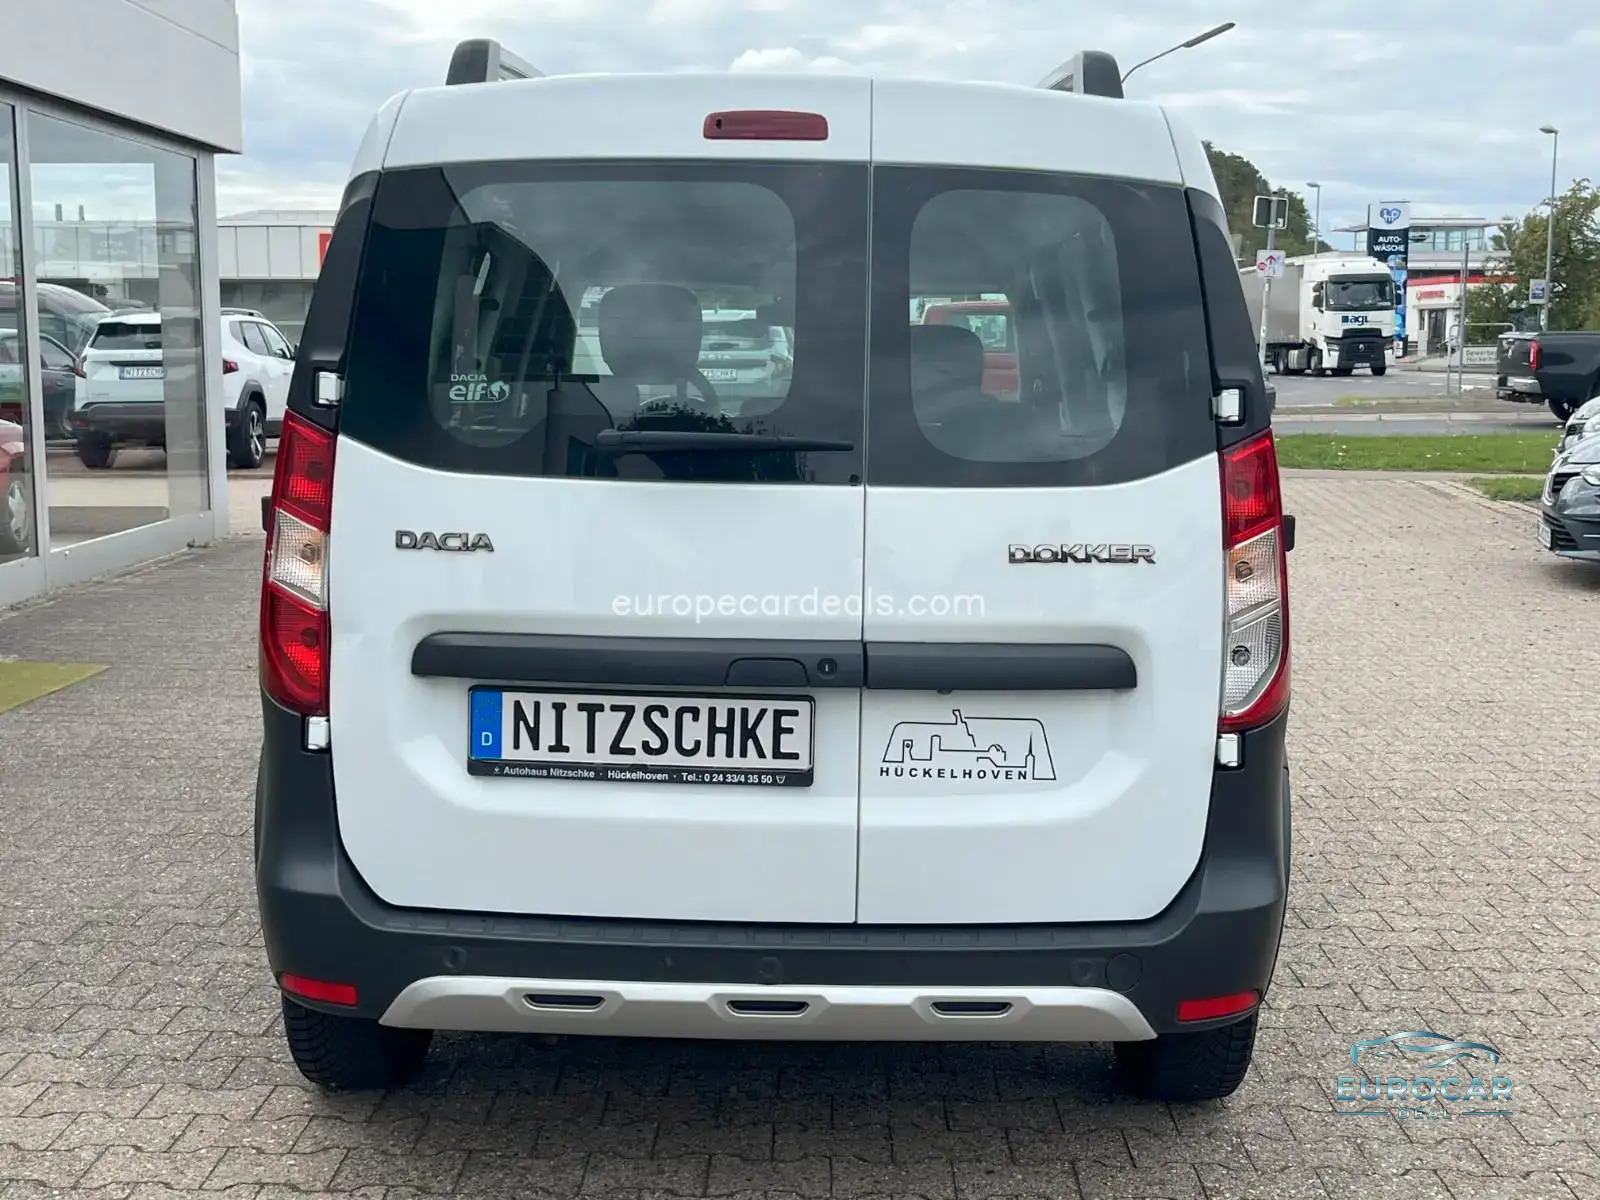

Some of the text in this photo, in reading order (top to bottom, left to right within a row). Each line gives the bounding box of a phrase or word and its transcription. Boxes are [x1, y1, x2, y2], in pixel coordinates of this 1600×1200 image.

[1377, 235, 1402, 243] AUTO-
[450, 373, 488, 382] DACIA
[449, 382, 488, 401] elf
[394, 529, 495, 552] DACIA
[1008, 543, 1157, 564] DOKKER
[481, 730, 493, 746] D
[512, 699, 800, 761] NITZSCHKE
[503, 765, 773, 784] Autohaus Nitzschke Hückelhoven Tel.: 0 24 33/4 35 50
[879, 764, 1028, 781] HÜCKELHOVEN
